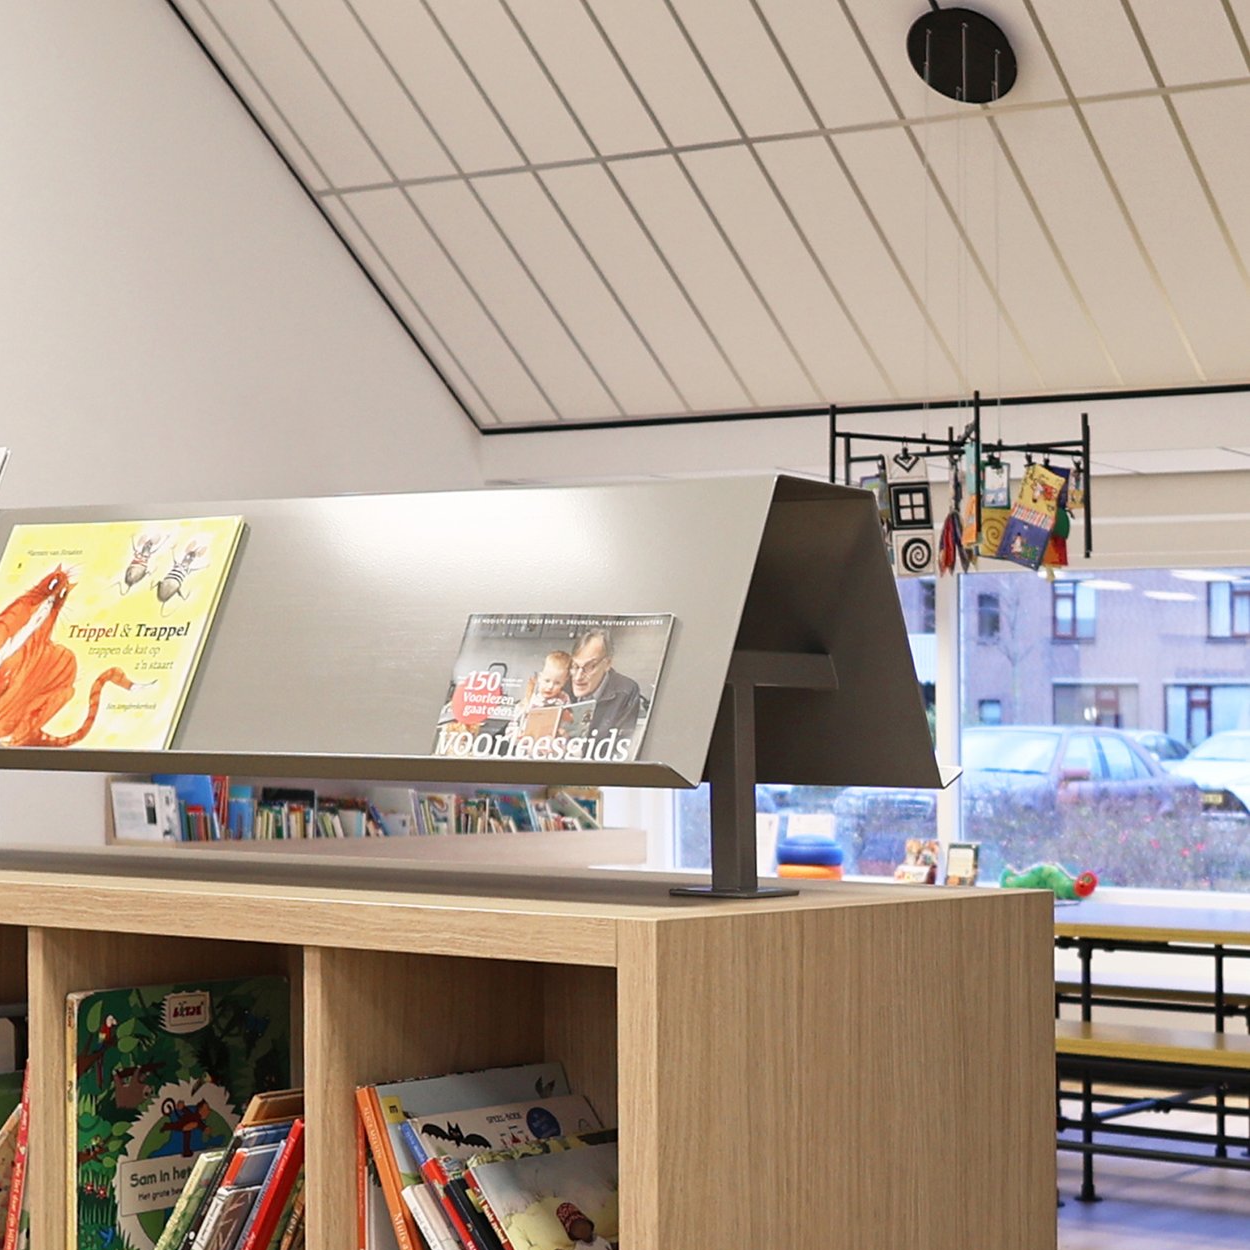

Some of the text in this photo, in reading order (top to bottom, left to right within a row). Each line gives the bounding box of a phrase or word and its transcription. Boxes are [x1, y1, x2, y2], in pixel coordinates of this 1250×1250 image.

[69, 621, 190, 642] Trippel & Trappel
[88, 645, 160, 658] trappen de kat op
[149, 661, 173, 670] staart
[465, 671, 501, 692] 150
[463, 691, 514, 705] Voorlezen
[462, 704, 487, 717] gaat
[130, 1172, 157, 1188] Sam
[390, 1211, 410, 1242] Muis
